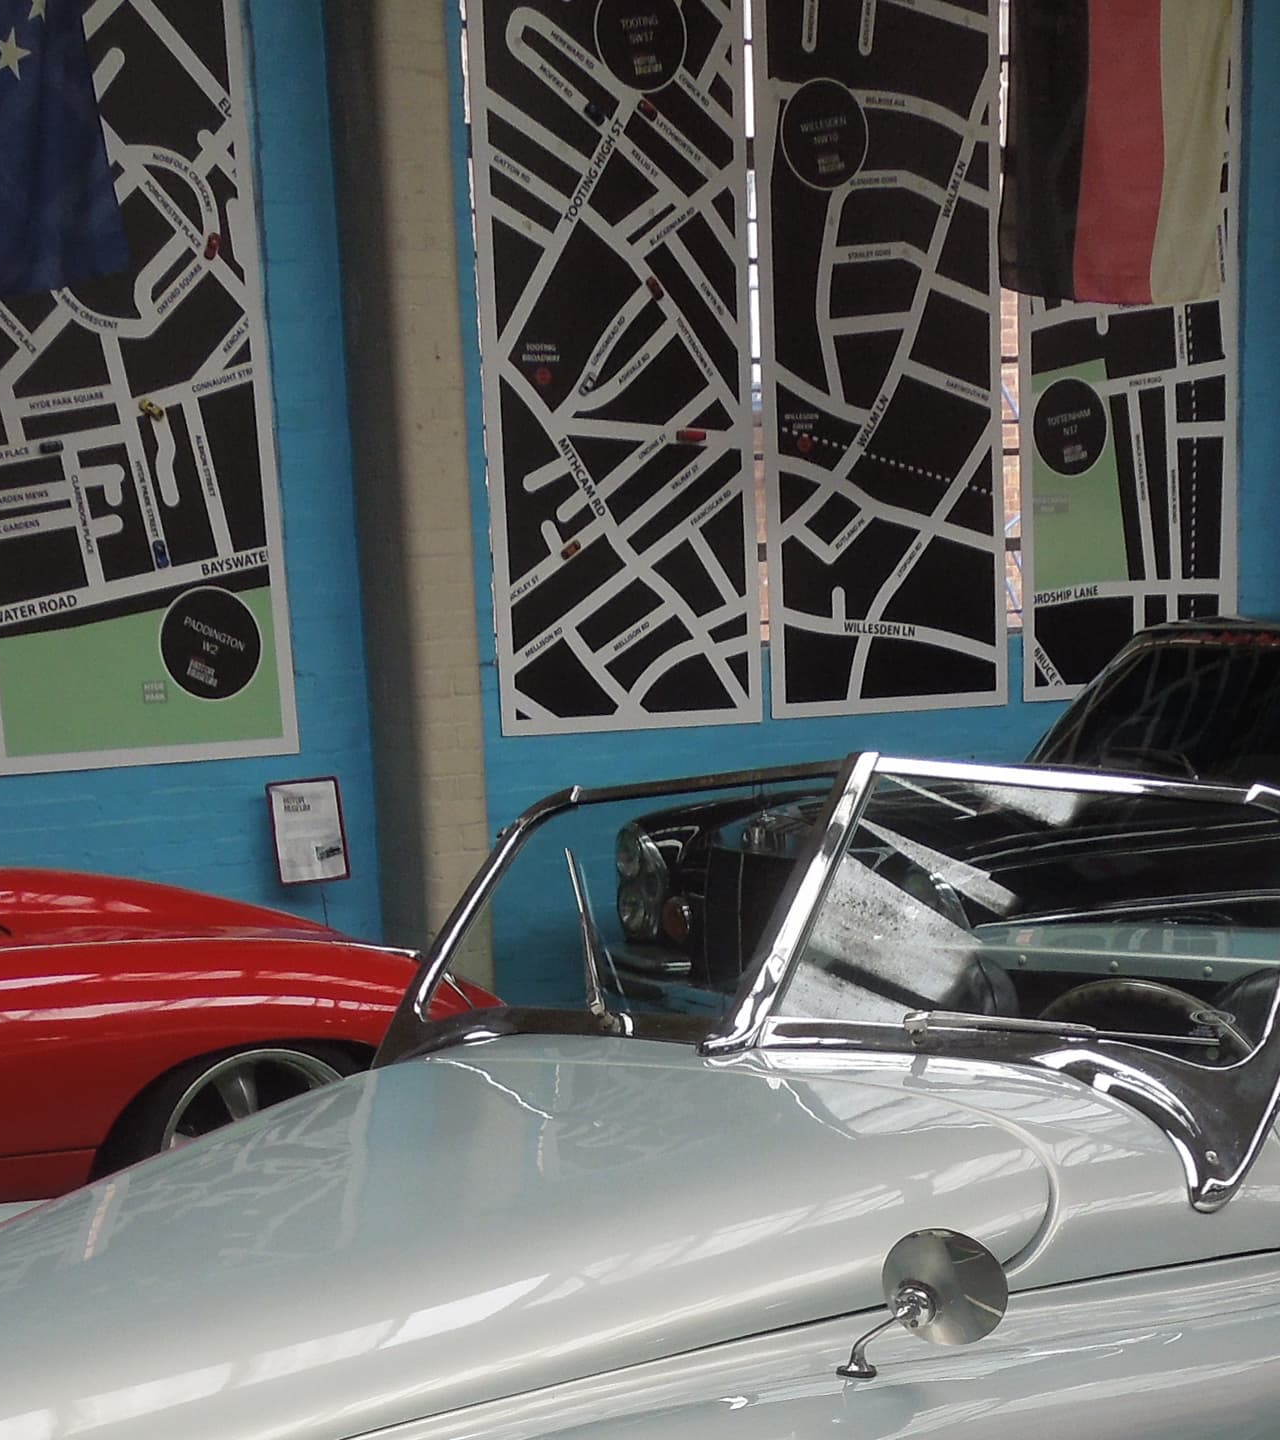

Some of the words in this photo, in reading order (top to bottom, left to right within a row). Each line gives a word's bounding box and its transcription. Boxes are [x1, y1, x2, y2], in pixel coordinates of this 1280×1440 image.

[563, 168, 599, 222] TOOTING
[592, 135, 615, 167] HIGH
[610, 118, 624, 135] ST
[189, 170, 213, 213] CRESCENT
[942, 179, 959, 217] WALM
[955, 160, 965, 176] LN
[142, 180, 184, 225] PORCHESTER
[181, 225, 201, 247] PLACE
[79, 307, 117, 333] CRESCENT
[15, 330, 36, 353] PLACE
[191, 371, 236, 392] CONNAUGHT
[73, 391, 103, 403] SQUARE
[857, 411, 881, 446] WALM
[875, 394, 888, 411] LN
[5, 447, 28, 457] PLACE
[195, 435, 207, 465] ALBION
[203, 467, 215, 496] STREET
[556, 438, 597, 497] MITHCAM
[591, 497, 606, 516] RD
[24, 490, 48, 500] MEWS
[134, 461, 144, 482] HYDE
[140, 485, 151, 506] PARK
[146, 509, 159, 537] STREET
[2, 519, 39, 532] GARDENS
[71, 475, 87, 525] CLARENDON
[83, 527, 93, 553] PLACE
[39, 595, 76, 612] ROAD
[1073, 586, 1098, 597] LANE
[182, 617, 246, 650] PADDINGTON
[553, 627, 562, 636] RD
[843, 621, 900, 635] WILLESDEN
[902, 626, 915, 636] LN
[201, 641, 218, 653] W2
